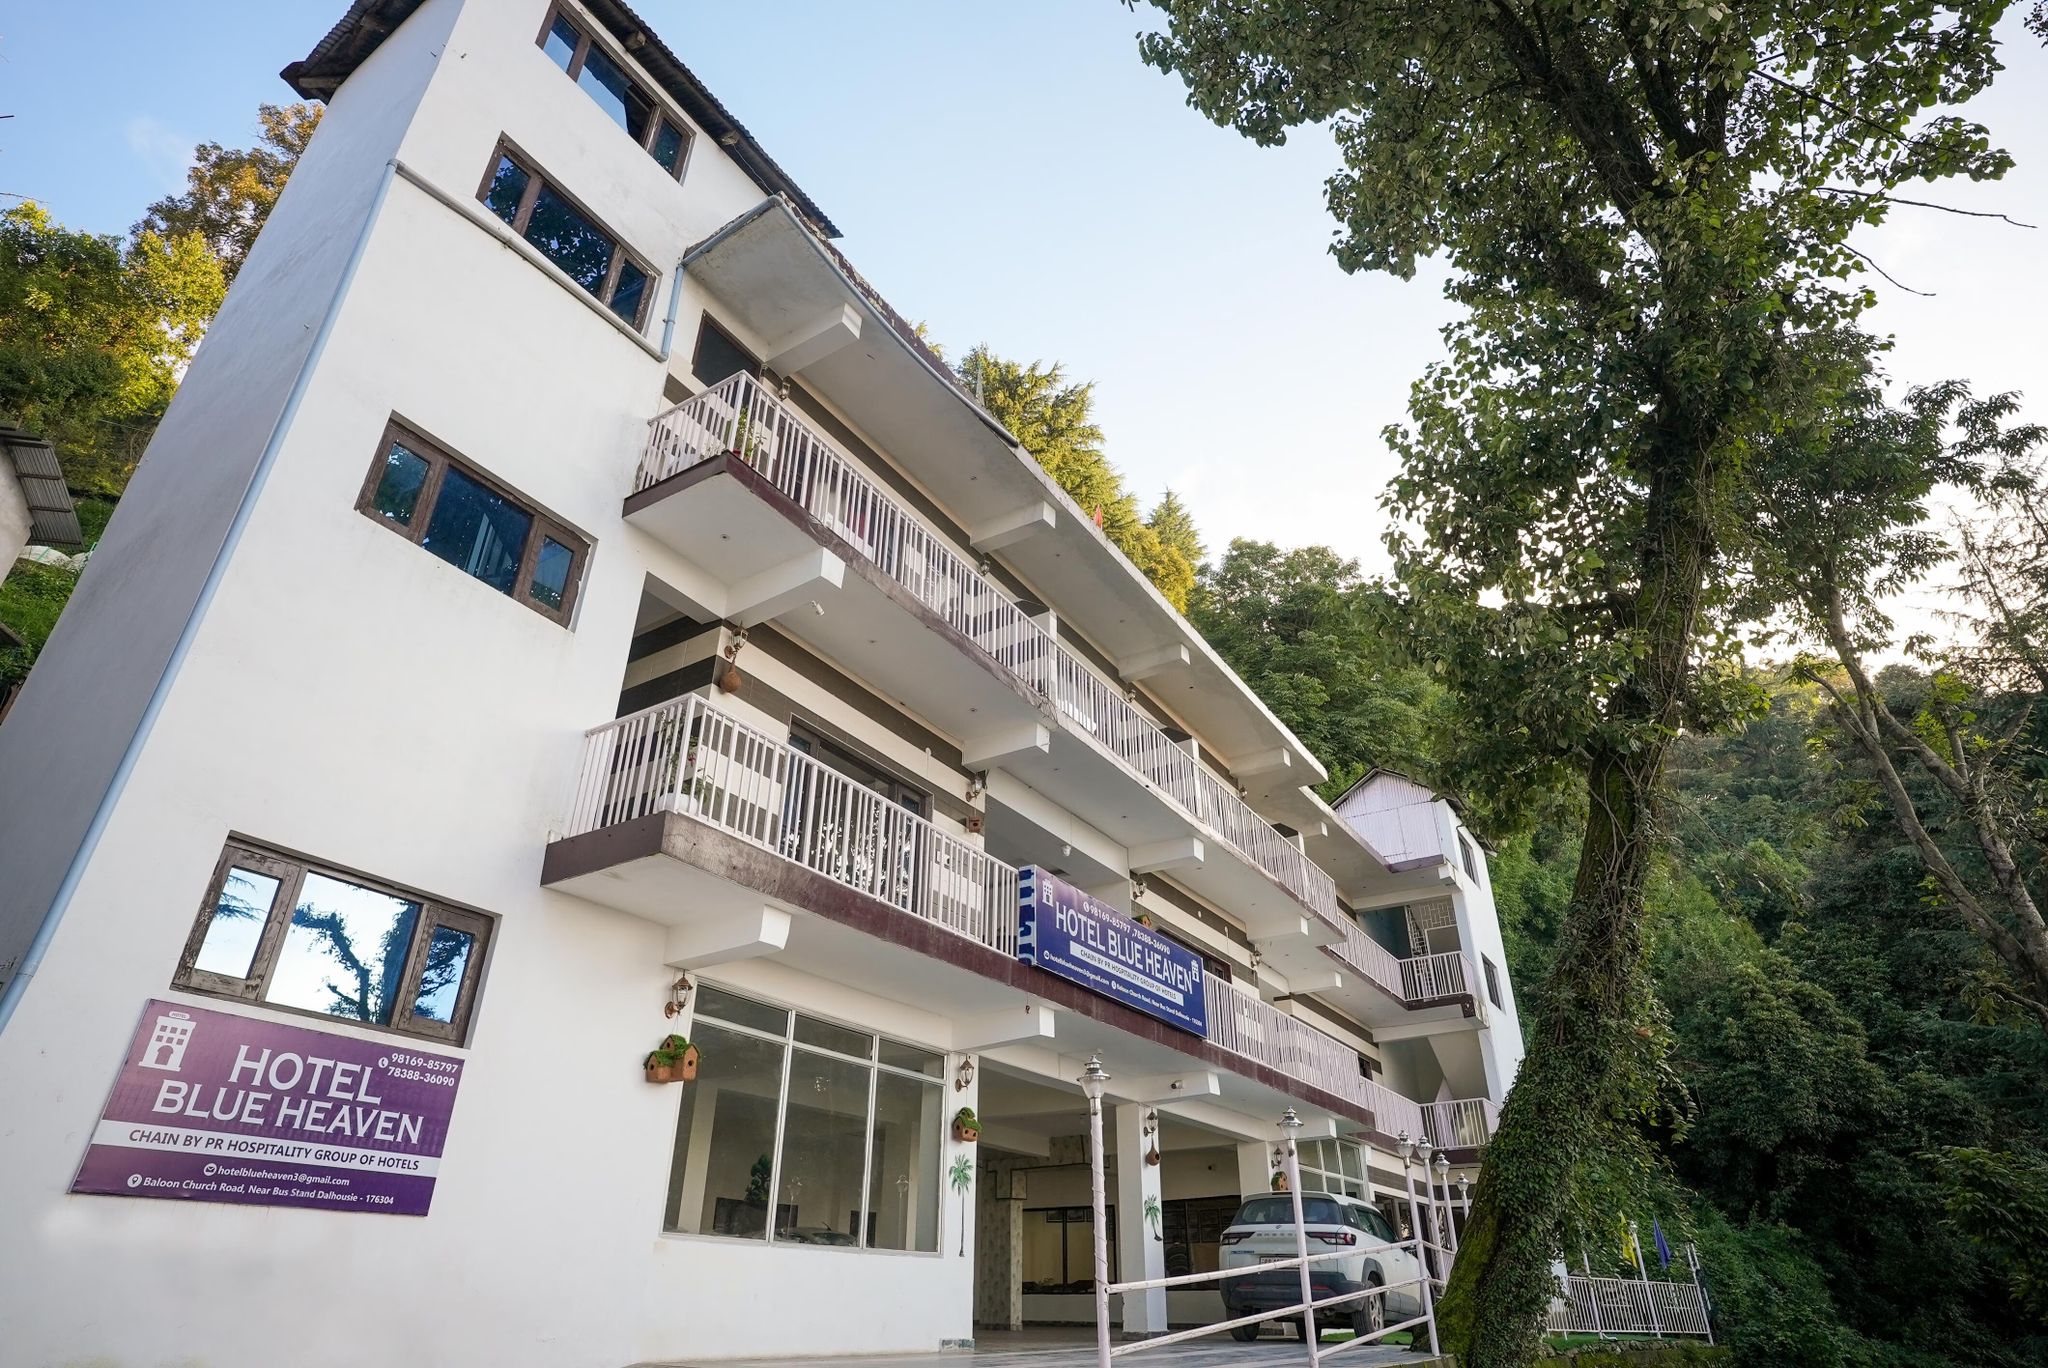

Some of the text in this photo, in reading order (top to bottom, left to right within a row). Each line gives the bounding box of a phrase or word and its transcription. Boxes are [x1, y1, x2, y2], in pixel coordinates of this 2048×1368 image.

[1090, 905, 1130, 933] 98169-85797
[1056, 901, 1105, 952] HOTEL
[1108, 928, 1143, 970] BLUE
[1145, 948, 1193, 994] HEAVEN
[1080, 949, 1176, 999] CHAIN BY PR HOSPITALITY GROUP OF HOTELS
[228, 1045, 382, 1105] HOTEL
[387, 1066, 455, 1087] 78388-36090
[391, 1053, 458, 1073] 98169-85797
[152, 1079, 425, 1144] BLUE HEAVEN
[129, 1130, 420, 1171] CHAIN BY PR HOSPITALITY GROUP OF HOTELS
[143, 1177, 180, 1188] Baloon
[182, 1180, 217, 1191] Church
[219, 1182, 245, 1194] Road,
[247, 1185, 271, 1195] Near
[272, 1187, 289, 1197] Bus
[290, 1188, 316, 1199] Stand
[316, 1190, 358, 1202] Dalhousie
[365, 1194, 394, 1205] 176304
[217, 1166, 350, 1186] hotelblueheaven3@gmail.com
